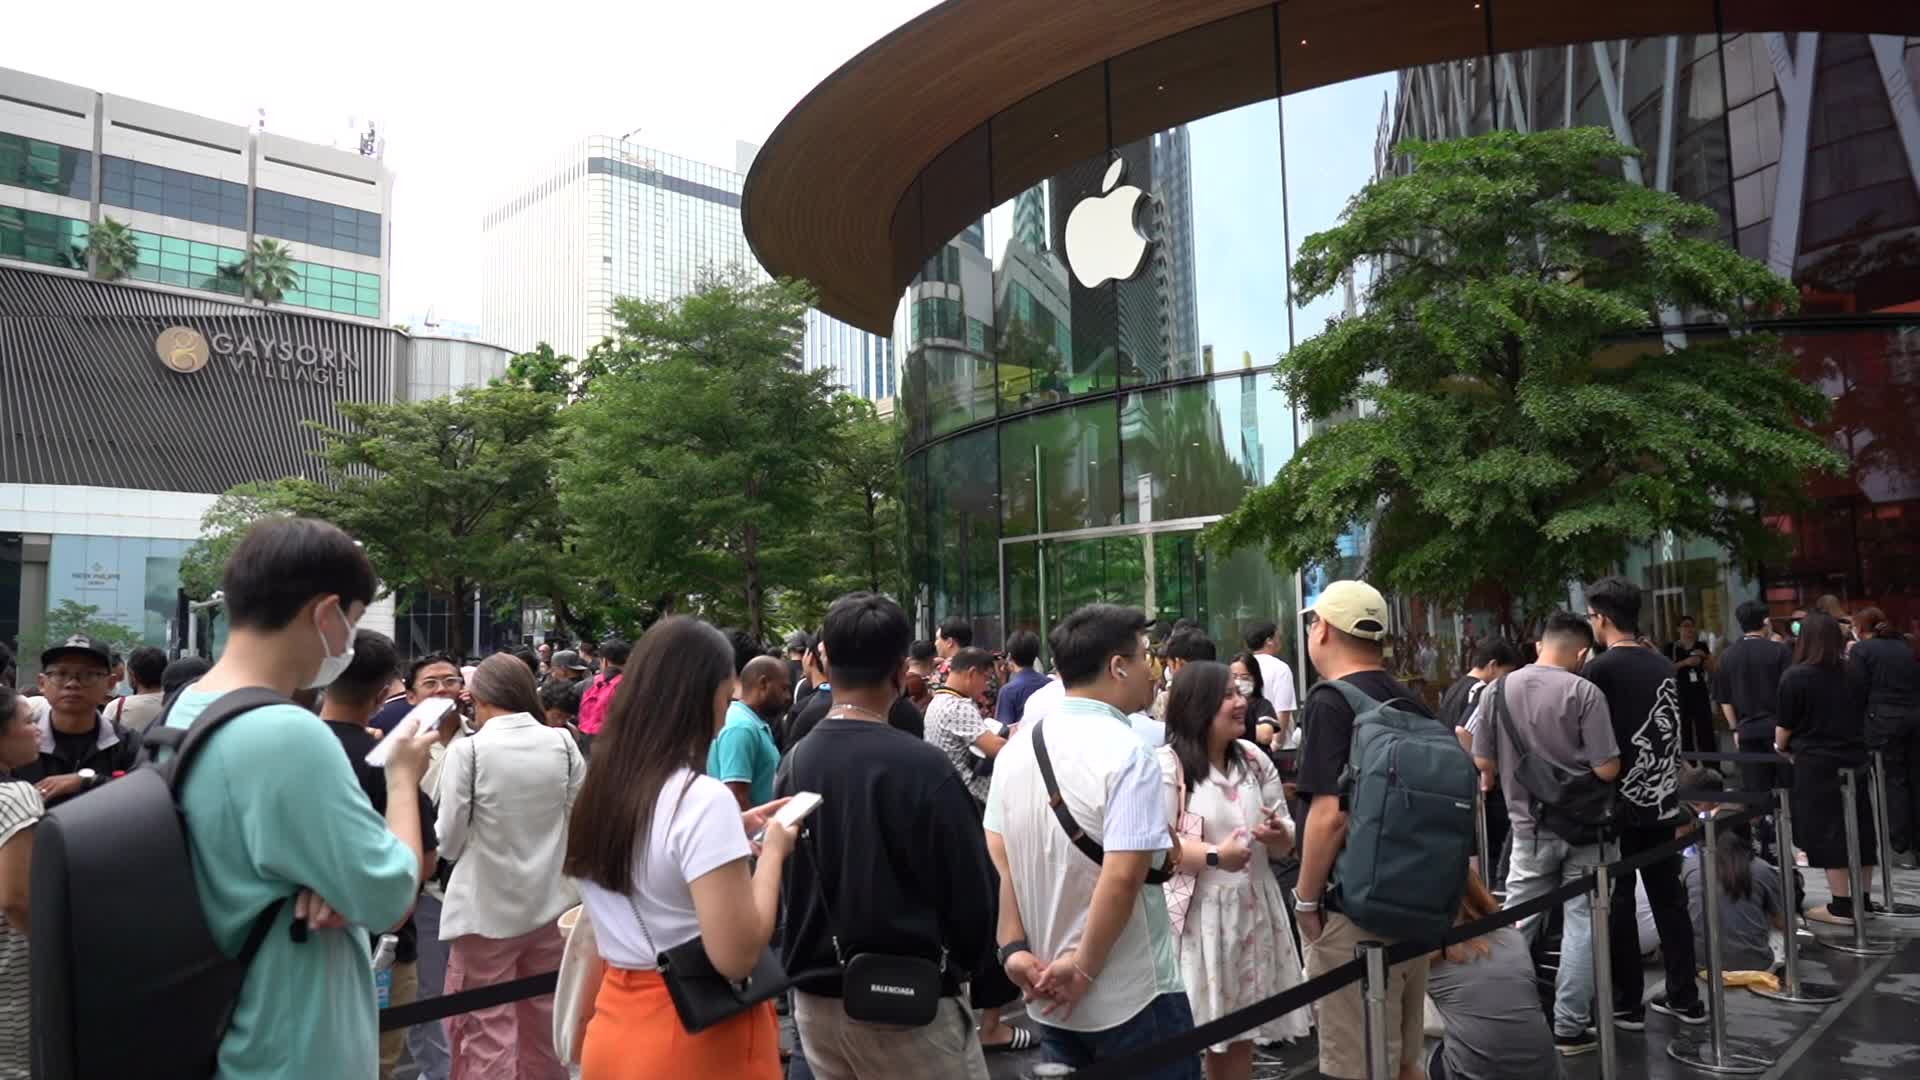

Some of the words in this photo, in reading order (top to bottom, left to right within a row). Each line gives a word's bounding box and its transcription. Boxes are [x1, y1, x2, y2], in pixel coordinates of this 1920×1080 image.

[212, 333, 360, 372] GAYSORN
[231, 356, 346, 388] VILLAGE
[871, 984, 915, 996] BALENCIAGA
